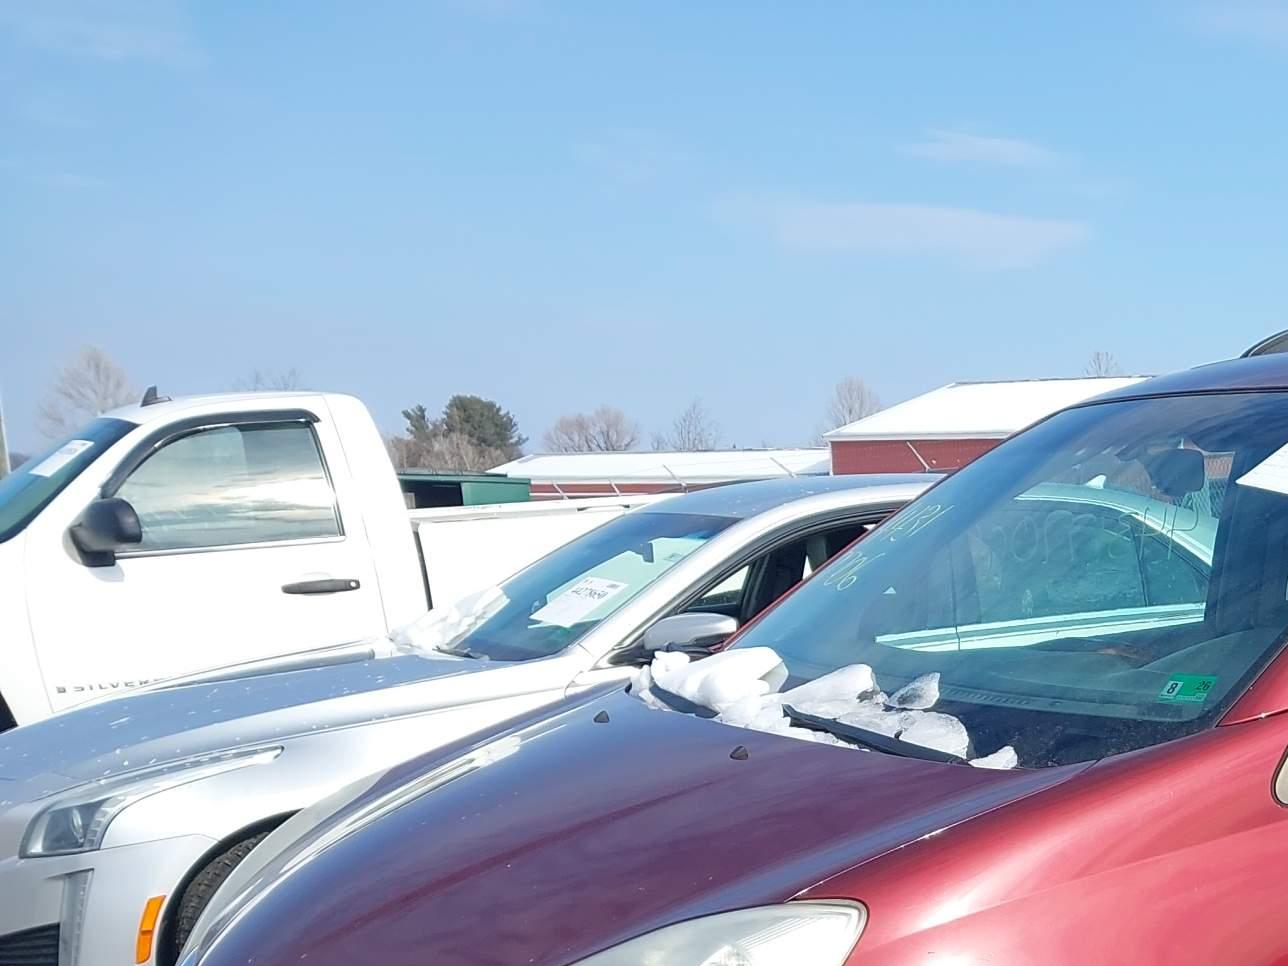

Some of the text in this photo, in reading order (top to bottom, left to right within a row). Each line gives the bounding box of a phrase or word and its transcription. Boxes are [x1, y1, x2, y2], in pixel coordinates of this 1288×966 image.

[72, 676, 164, 694] SILVER
[1166, 680, 1213, 695] 8 26
